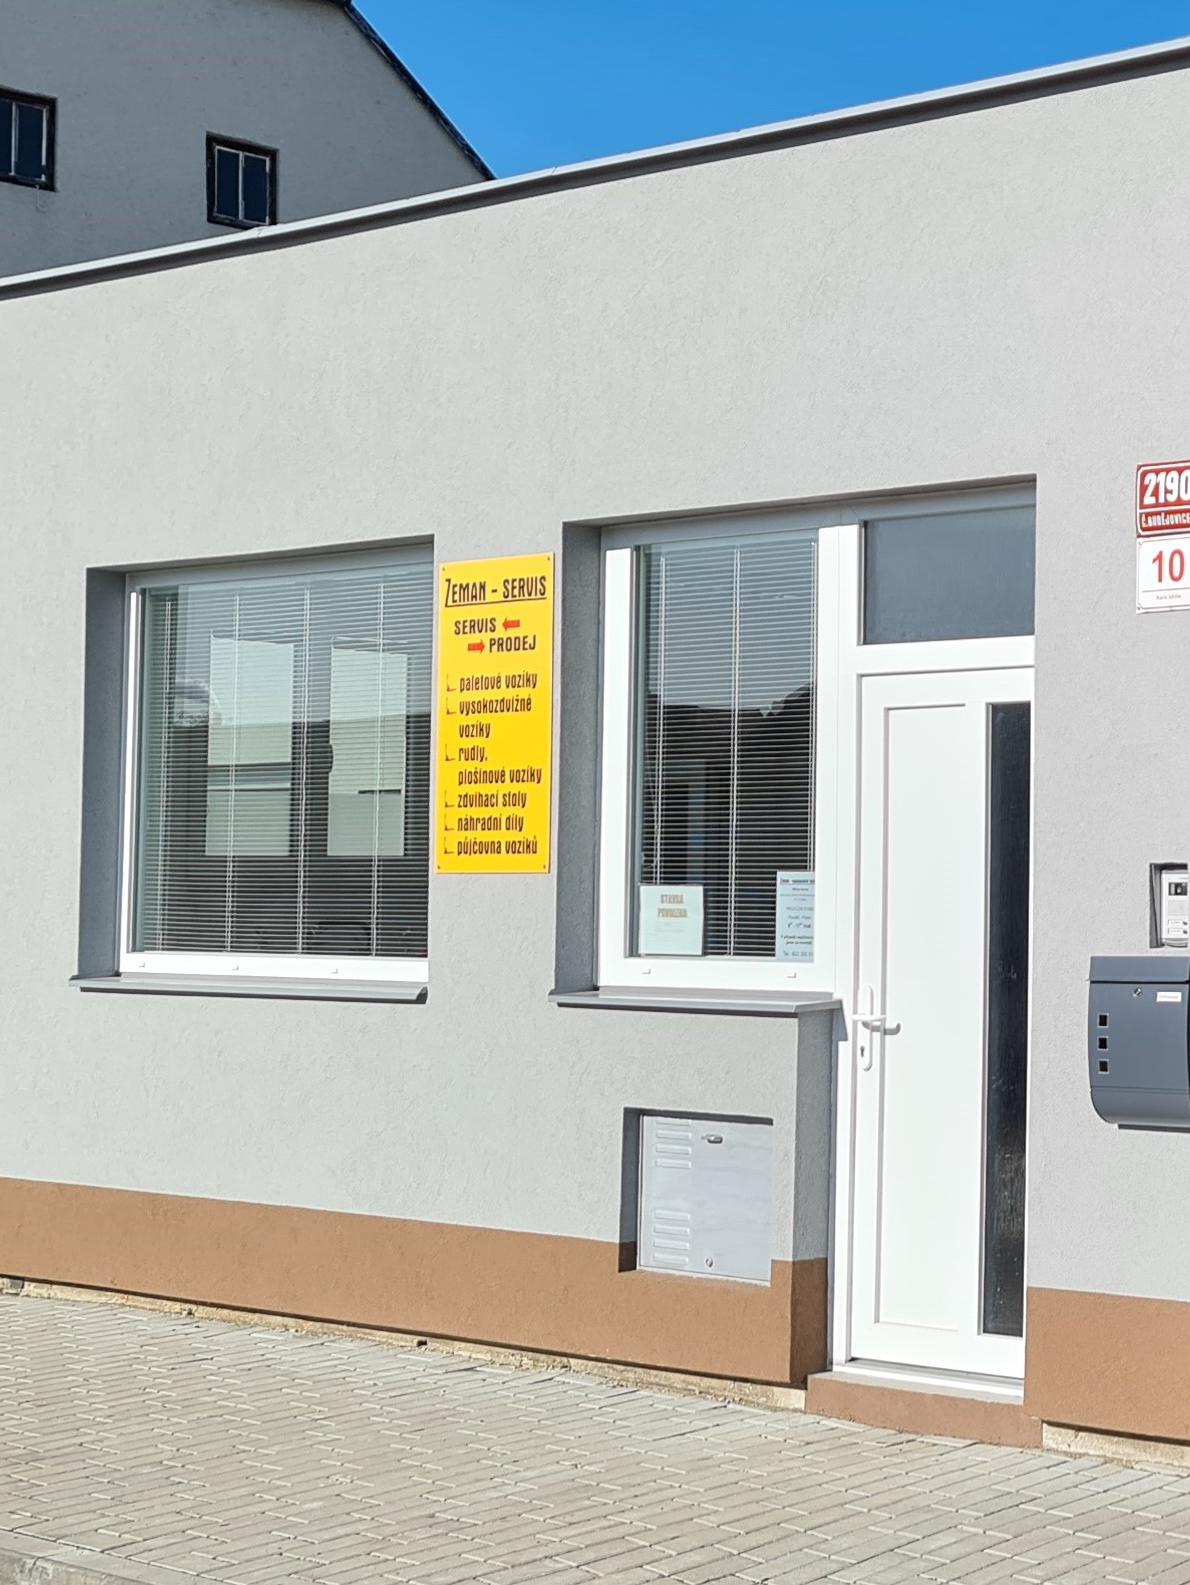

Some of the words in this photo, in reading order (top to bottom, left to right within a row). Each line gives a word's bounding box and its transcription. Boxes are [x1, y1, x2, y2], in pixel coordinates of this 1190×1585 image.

[1152, 548, 1185, 583] 10
[445, 577, 486, 607] ZEMAN
[502, 575, 546, 600] SERVIS
[454, 617, 497, 636] SERVIS
[489, 634, 536, 653] PRODEJ
[459, 672, 501, 693] paletové
[505, 670, 537, 689] vozíky
[459, 693, 532, 716] vysokozdvižné
[459, 720, 491, 739] vozíky
[458, 766, 506, 786] plošinové
[509, 765, 542, 784] vozíky
[457, 789, 499, 808] zdvihací
[502, 790, 527, 809] stoly
[457, 813, 502, 832] náhradní
[505, 813, 524, 832] díly
[457, 836, 501, 856] půjčovna
[505, 835, 538, 855] vozíků
